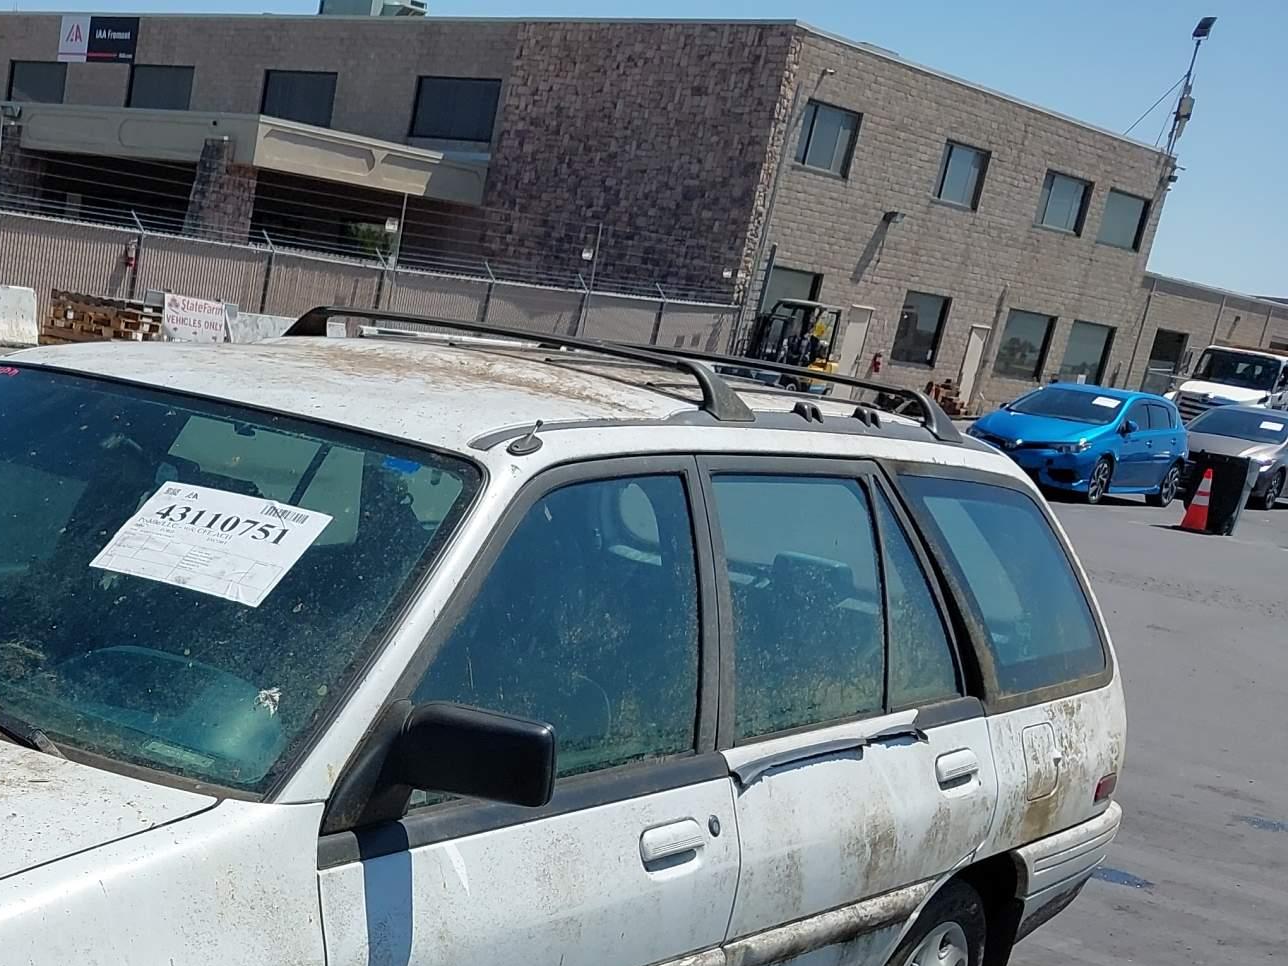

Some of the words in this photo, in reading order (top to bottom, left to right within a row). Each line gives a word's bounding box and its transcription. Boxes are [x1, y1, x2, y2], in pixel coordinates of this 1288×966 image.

[96, 29, 107, 39] IAA
[167, 314, 202, 328] VEHICLES
[204, 320, 223, 332] ONLY
[156, 504, 289, 545] 43110751
